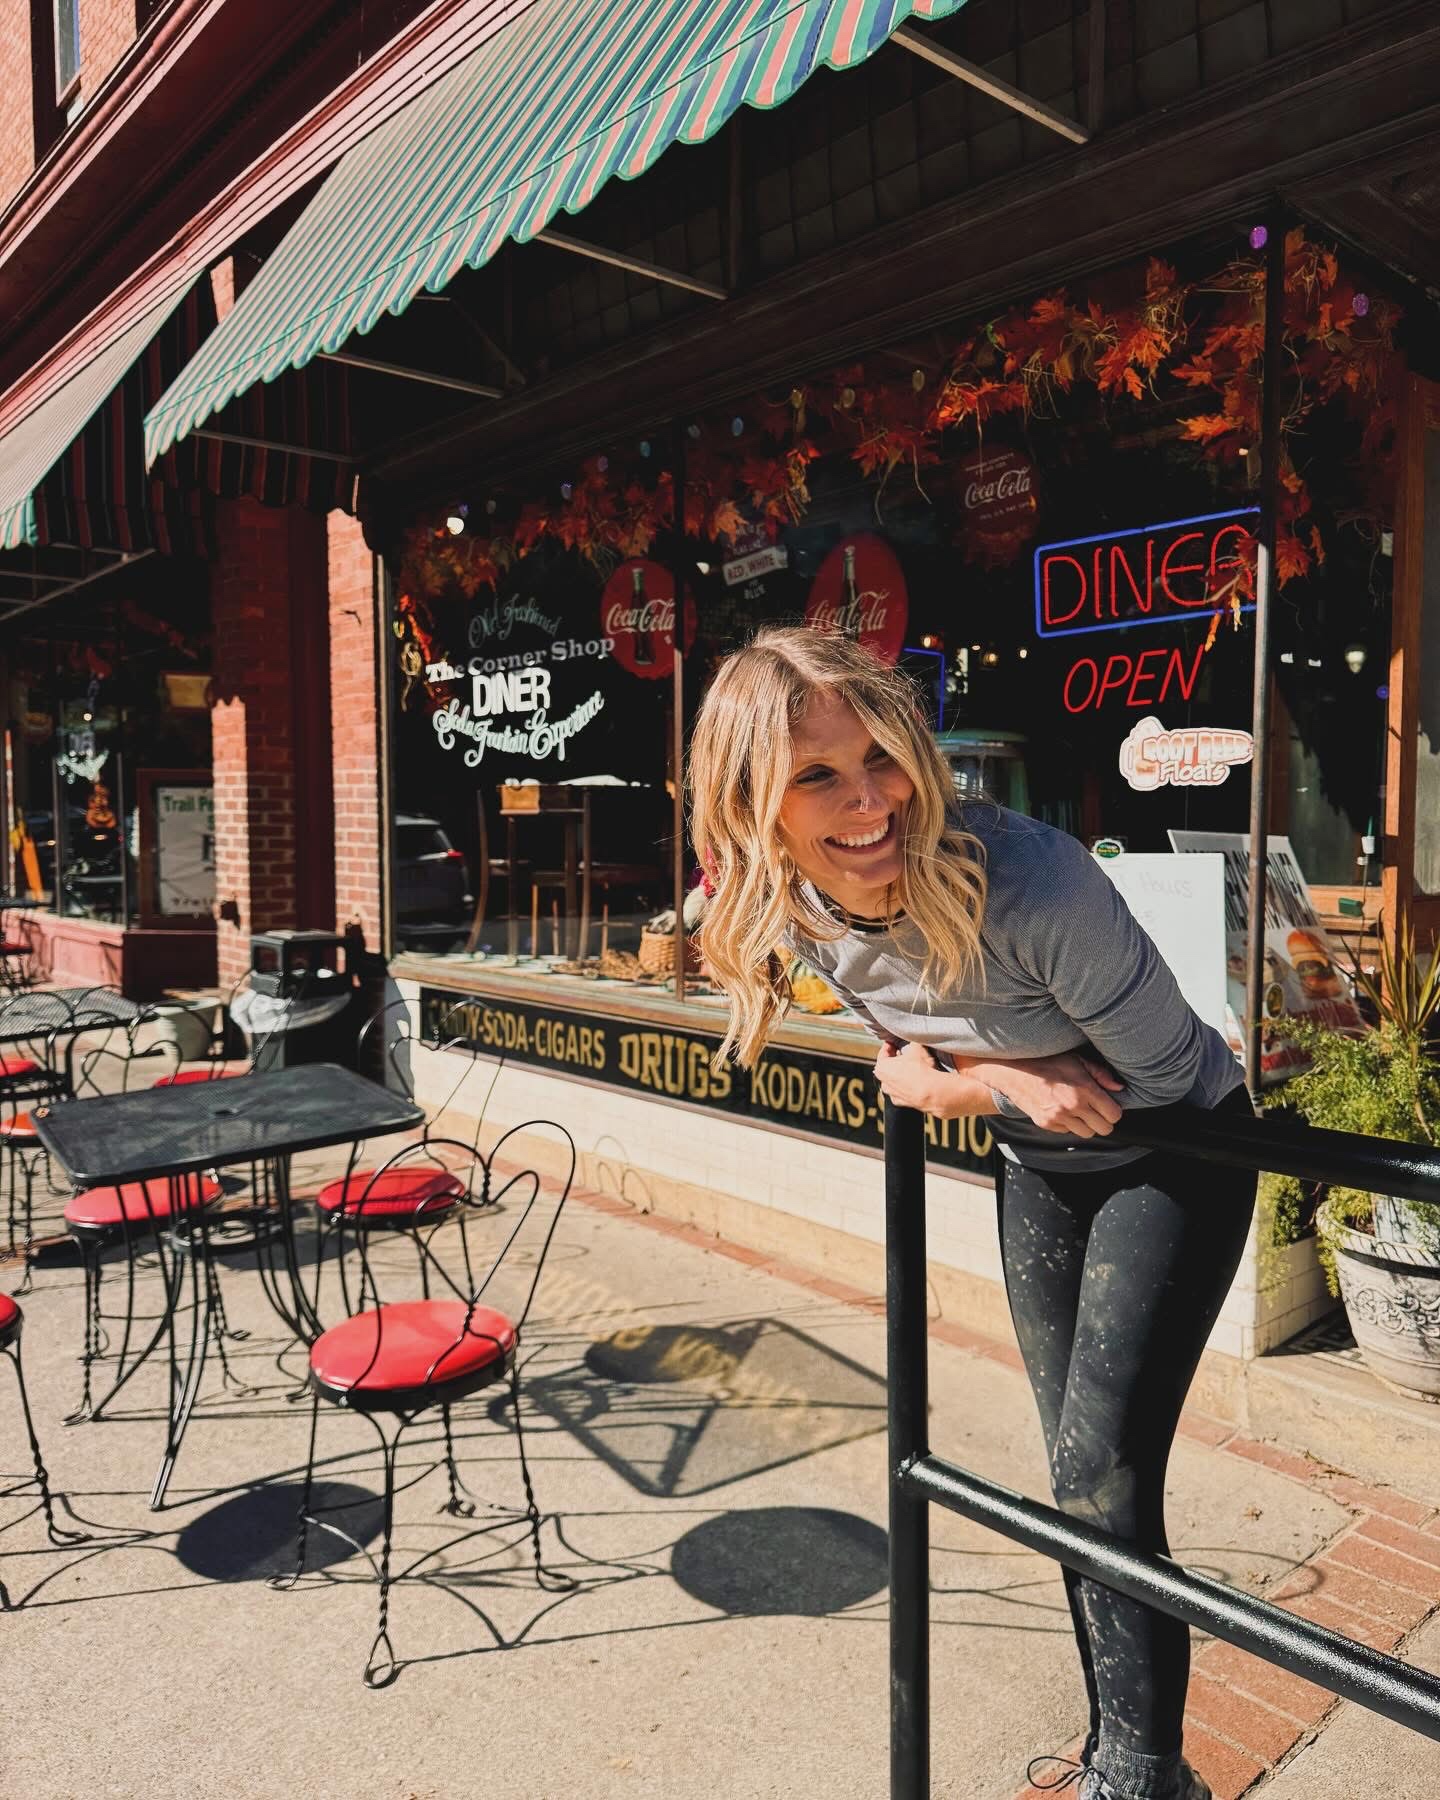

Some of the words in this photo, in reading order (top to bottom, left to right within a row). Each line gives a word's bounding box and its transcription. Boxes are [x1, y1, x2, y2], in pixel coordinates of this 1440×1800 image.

[964, 463, 1031, 509] Coca-Cola
[1043, 524, 1256, 625] DINER
[606, 598, 676, 635] Coca-Cola
[425, 659, 465, 683] The
[467, 649, 547, 676] Corner
[551, 637, 615, 661] Shop
[1063, 644, 1205, 713] OPEN
[472, 667, 551, 717] DINER
[432, 698, 476, 750] Soda
[1160, 761, 1227, 784] Floats
[162, 795, 195, 813] Trail
[618, 1032, 733, 1099] DRUGS
